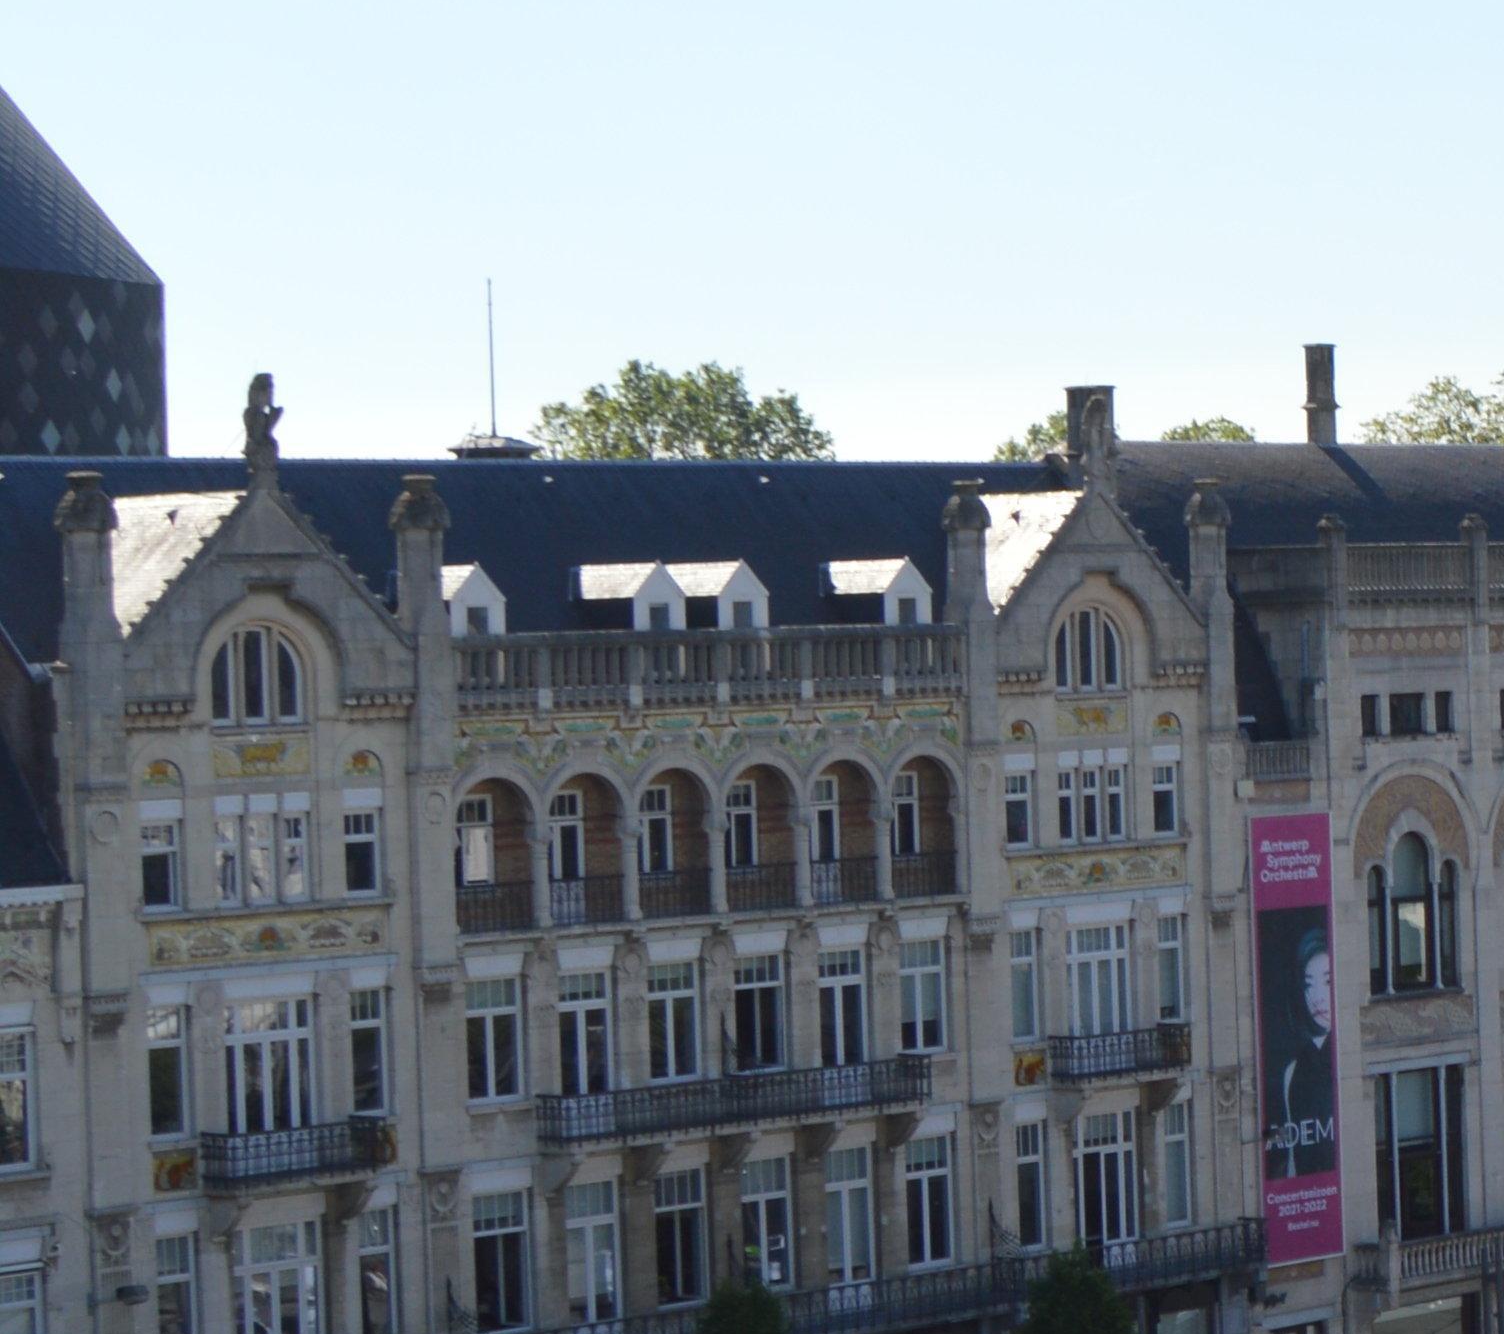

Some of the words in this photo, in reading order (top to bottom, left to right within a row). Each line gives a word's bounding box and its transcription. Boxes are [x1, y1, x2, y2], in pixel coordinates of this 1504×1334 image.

[1260, 839, 1309, 854] Antwerp
[1267, 853, 1321, 870] Symphony
[1279, 1199, 1327, 1217] 2021-2022
